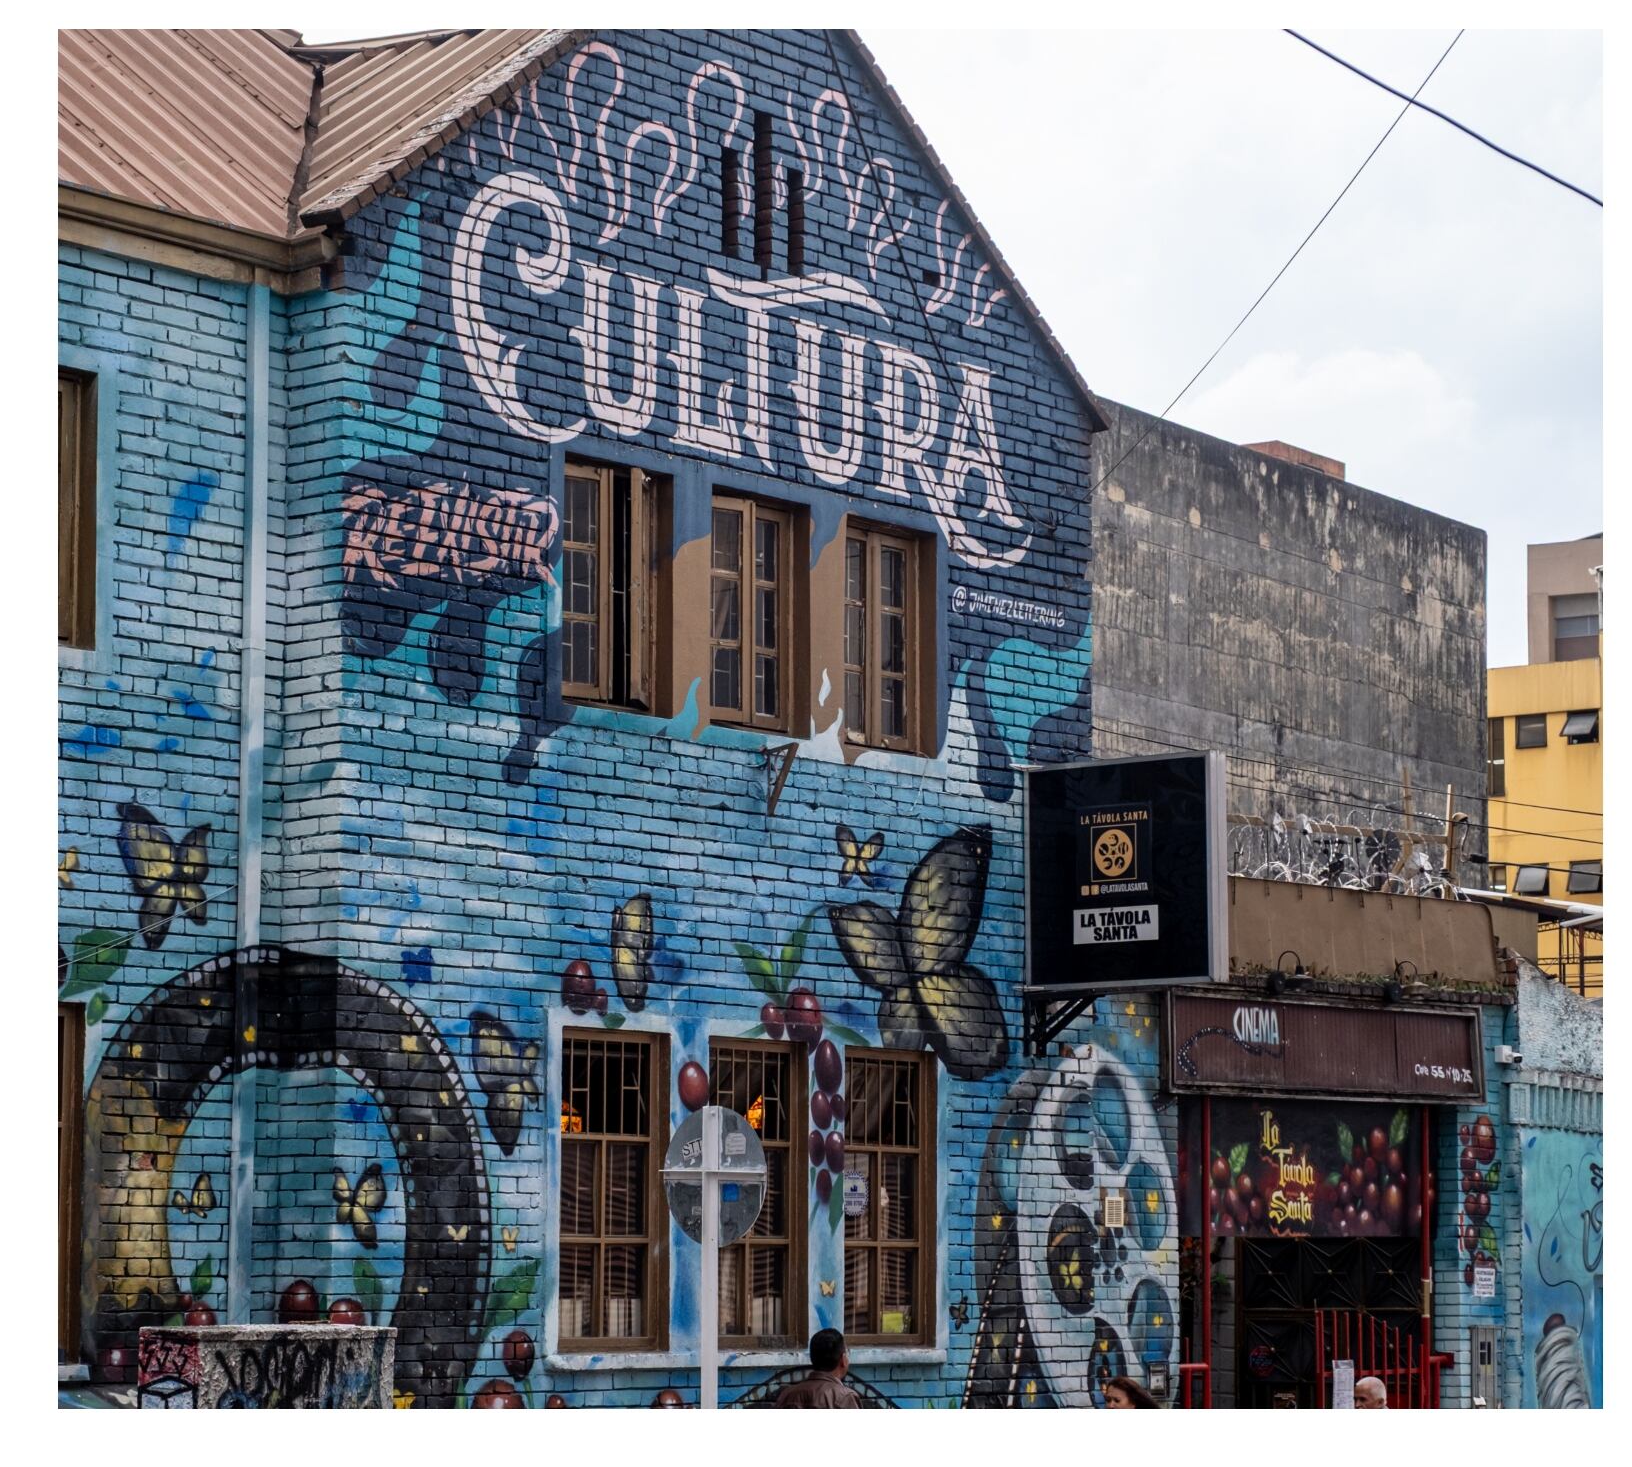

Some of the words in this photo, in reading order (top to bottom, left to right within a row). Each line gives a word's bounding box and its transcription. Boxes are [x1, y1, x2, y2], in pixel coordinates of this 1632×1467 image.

[451, 171, 1032, 569] CULTURA
[952, 586, 1065, 628] @JIMENEZLETTERING
[1080, 815, 1090, 825] LA
[1092, 812, 1121, 825] TÁVOLA
[1123, 811, 1148, 821] SANTA
[1080, 913, 1096, 927] LA
[1099, 907, 1151, 927] TÁVOLA
[1093, 925, 1138, 941] SANTA
[1233, 1006, 1280, 1045] CINEMA
[1431, 1065, 1445, 1078] 55
[1269, 1190, 1312, 1225] Santa
